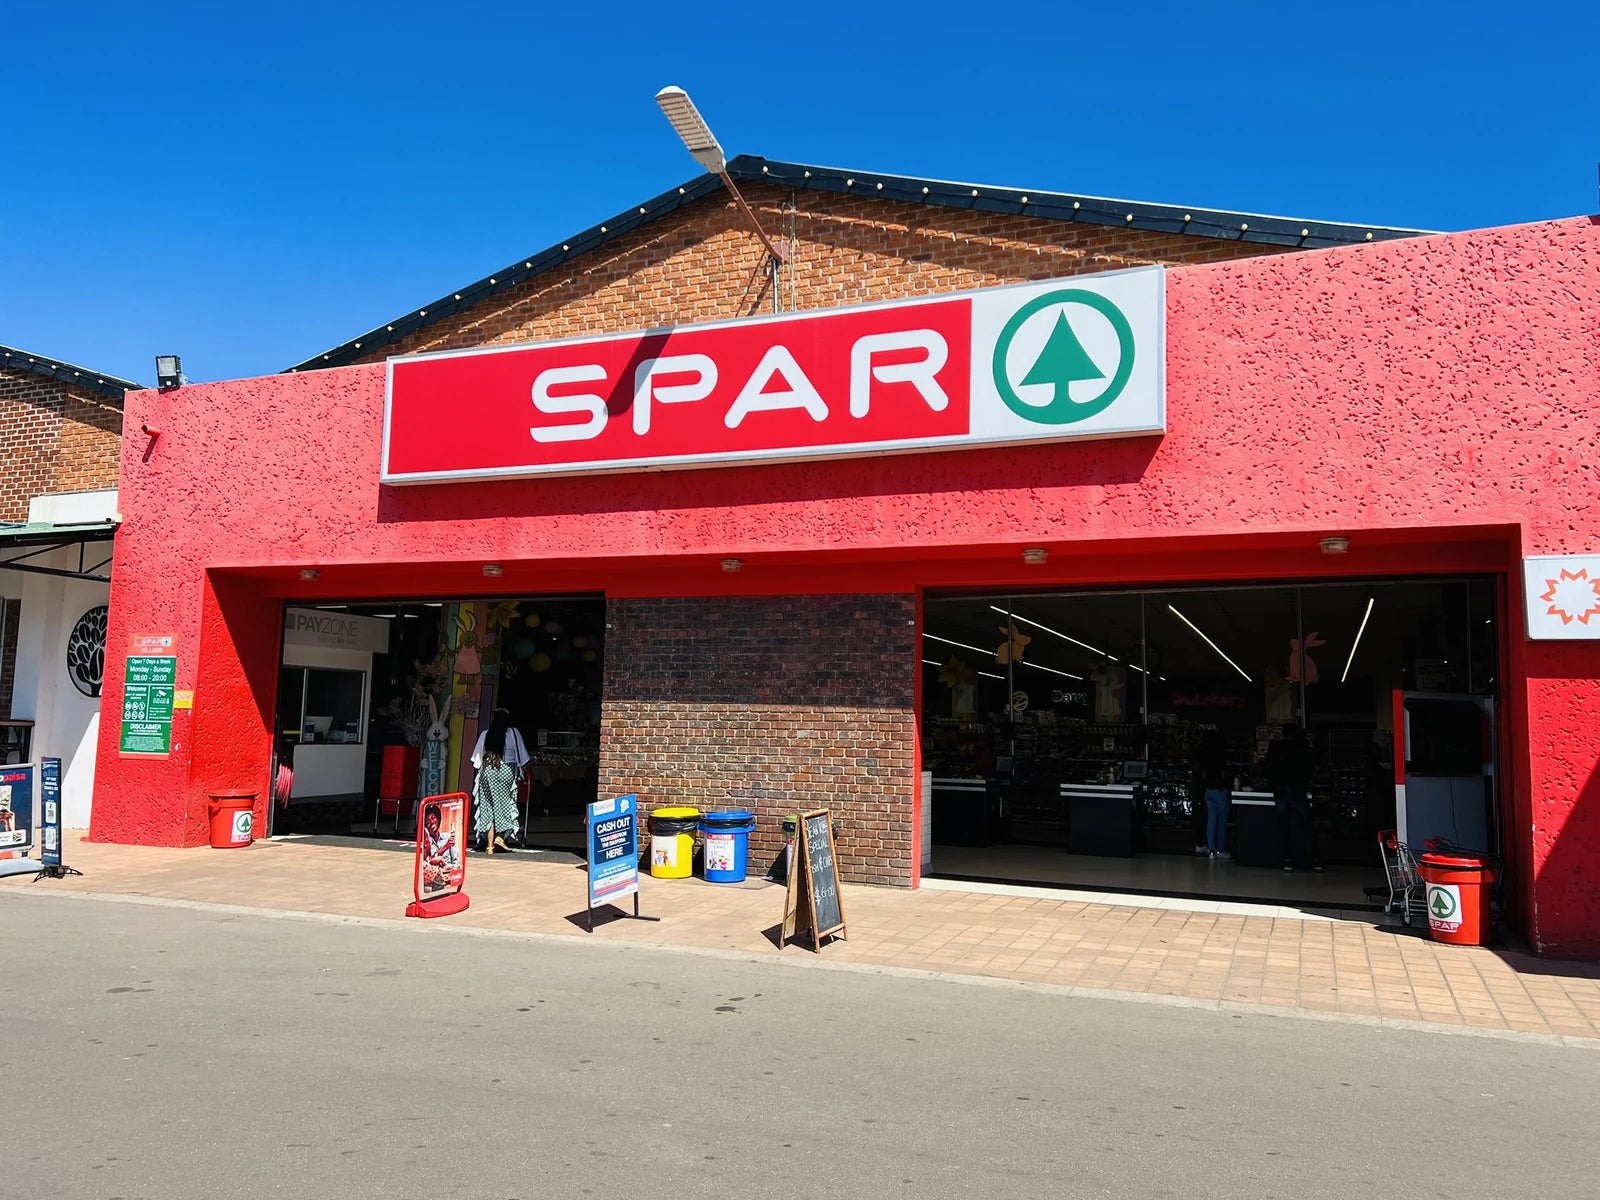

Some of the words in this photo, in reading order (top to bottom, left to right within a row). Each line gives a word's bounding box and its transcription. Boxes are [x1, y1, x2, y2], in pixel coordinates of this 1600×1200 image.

[530, 329, 948, 443] SPAR
[297, 614, 358, 637] PAYZONE
[129, 665, 149, 673] Monday
[153, 665, 172, 673] Sunday
[596, 820, 616, 834] CASH
[616, 816, 631, 829] OUT
[605, 846, 624, 860] HERE
